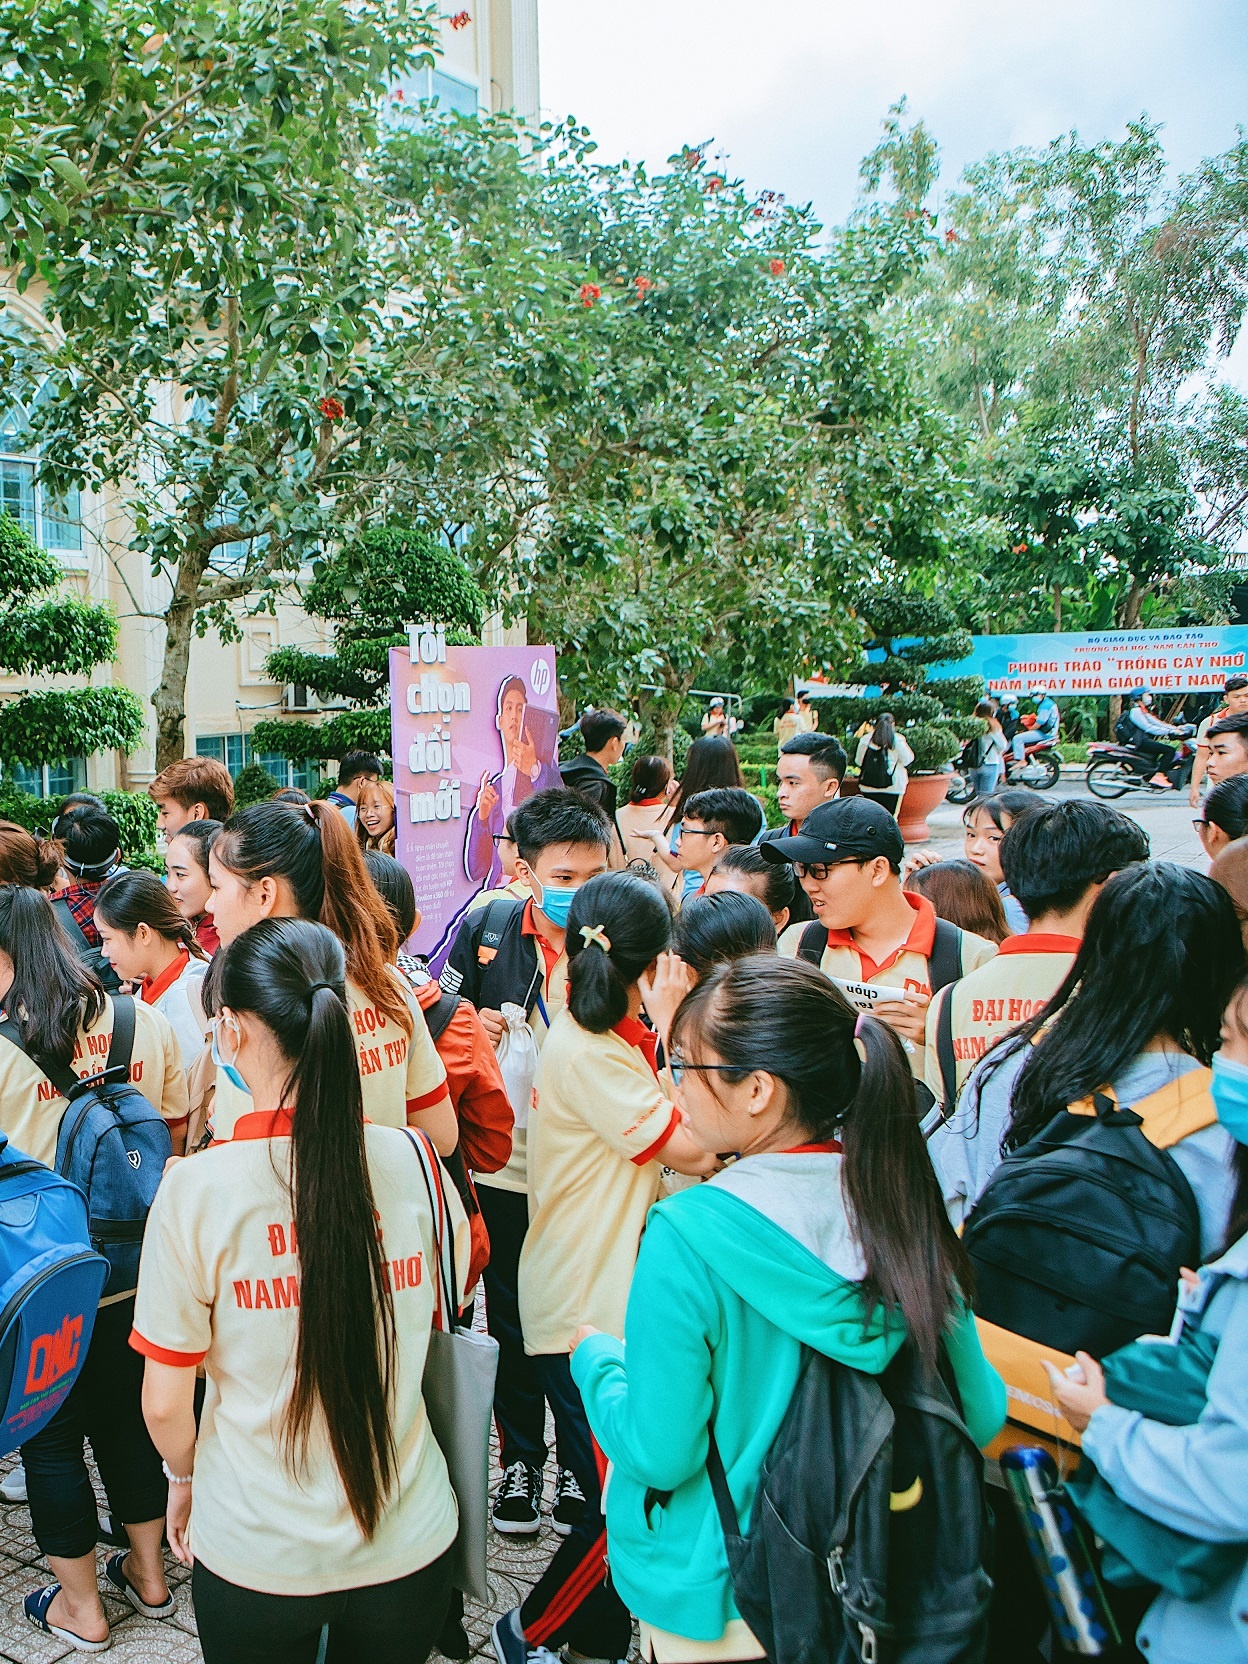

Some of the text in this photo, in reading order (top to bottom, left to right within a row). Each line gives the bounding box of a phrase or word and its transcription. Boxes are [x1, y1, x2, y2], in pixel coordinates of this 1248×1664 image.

[405, 622, 446, 663] Tôi
[532, 658, 550, 694] hp
[1008, 661, 1058, 674] PHONG
[1173, 654, 1204, 669] CÂY
[1108, 674, 1143, 688] GIÁO
[1150, 674, 1182, 690] VIỆT
[1188, 673, 1225, 687] NAM
[407, 675, 471, 723] chọn
[409, 723, 452, 773] đổi
[410, 780, 461, 823] mới
[846, 984, 878, 999] chọn
[972, 999, 1004, 1027] ĐẠI
[233, 1276, 301, 1310] NAM
